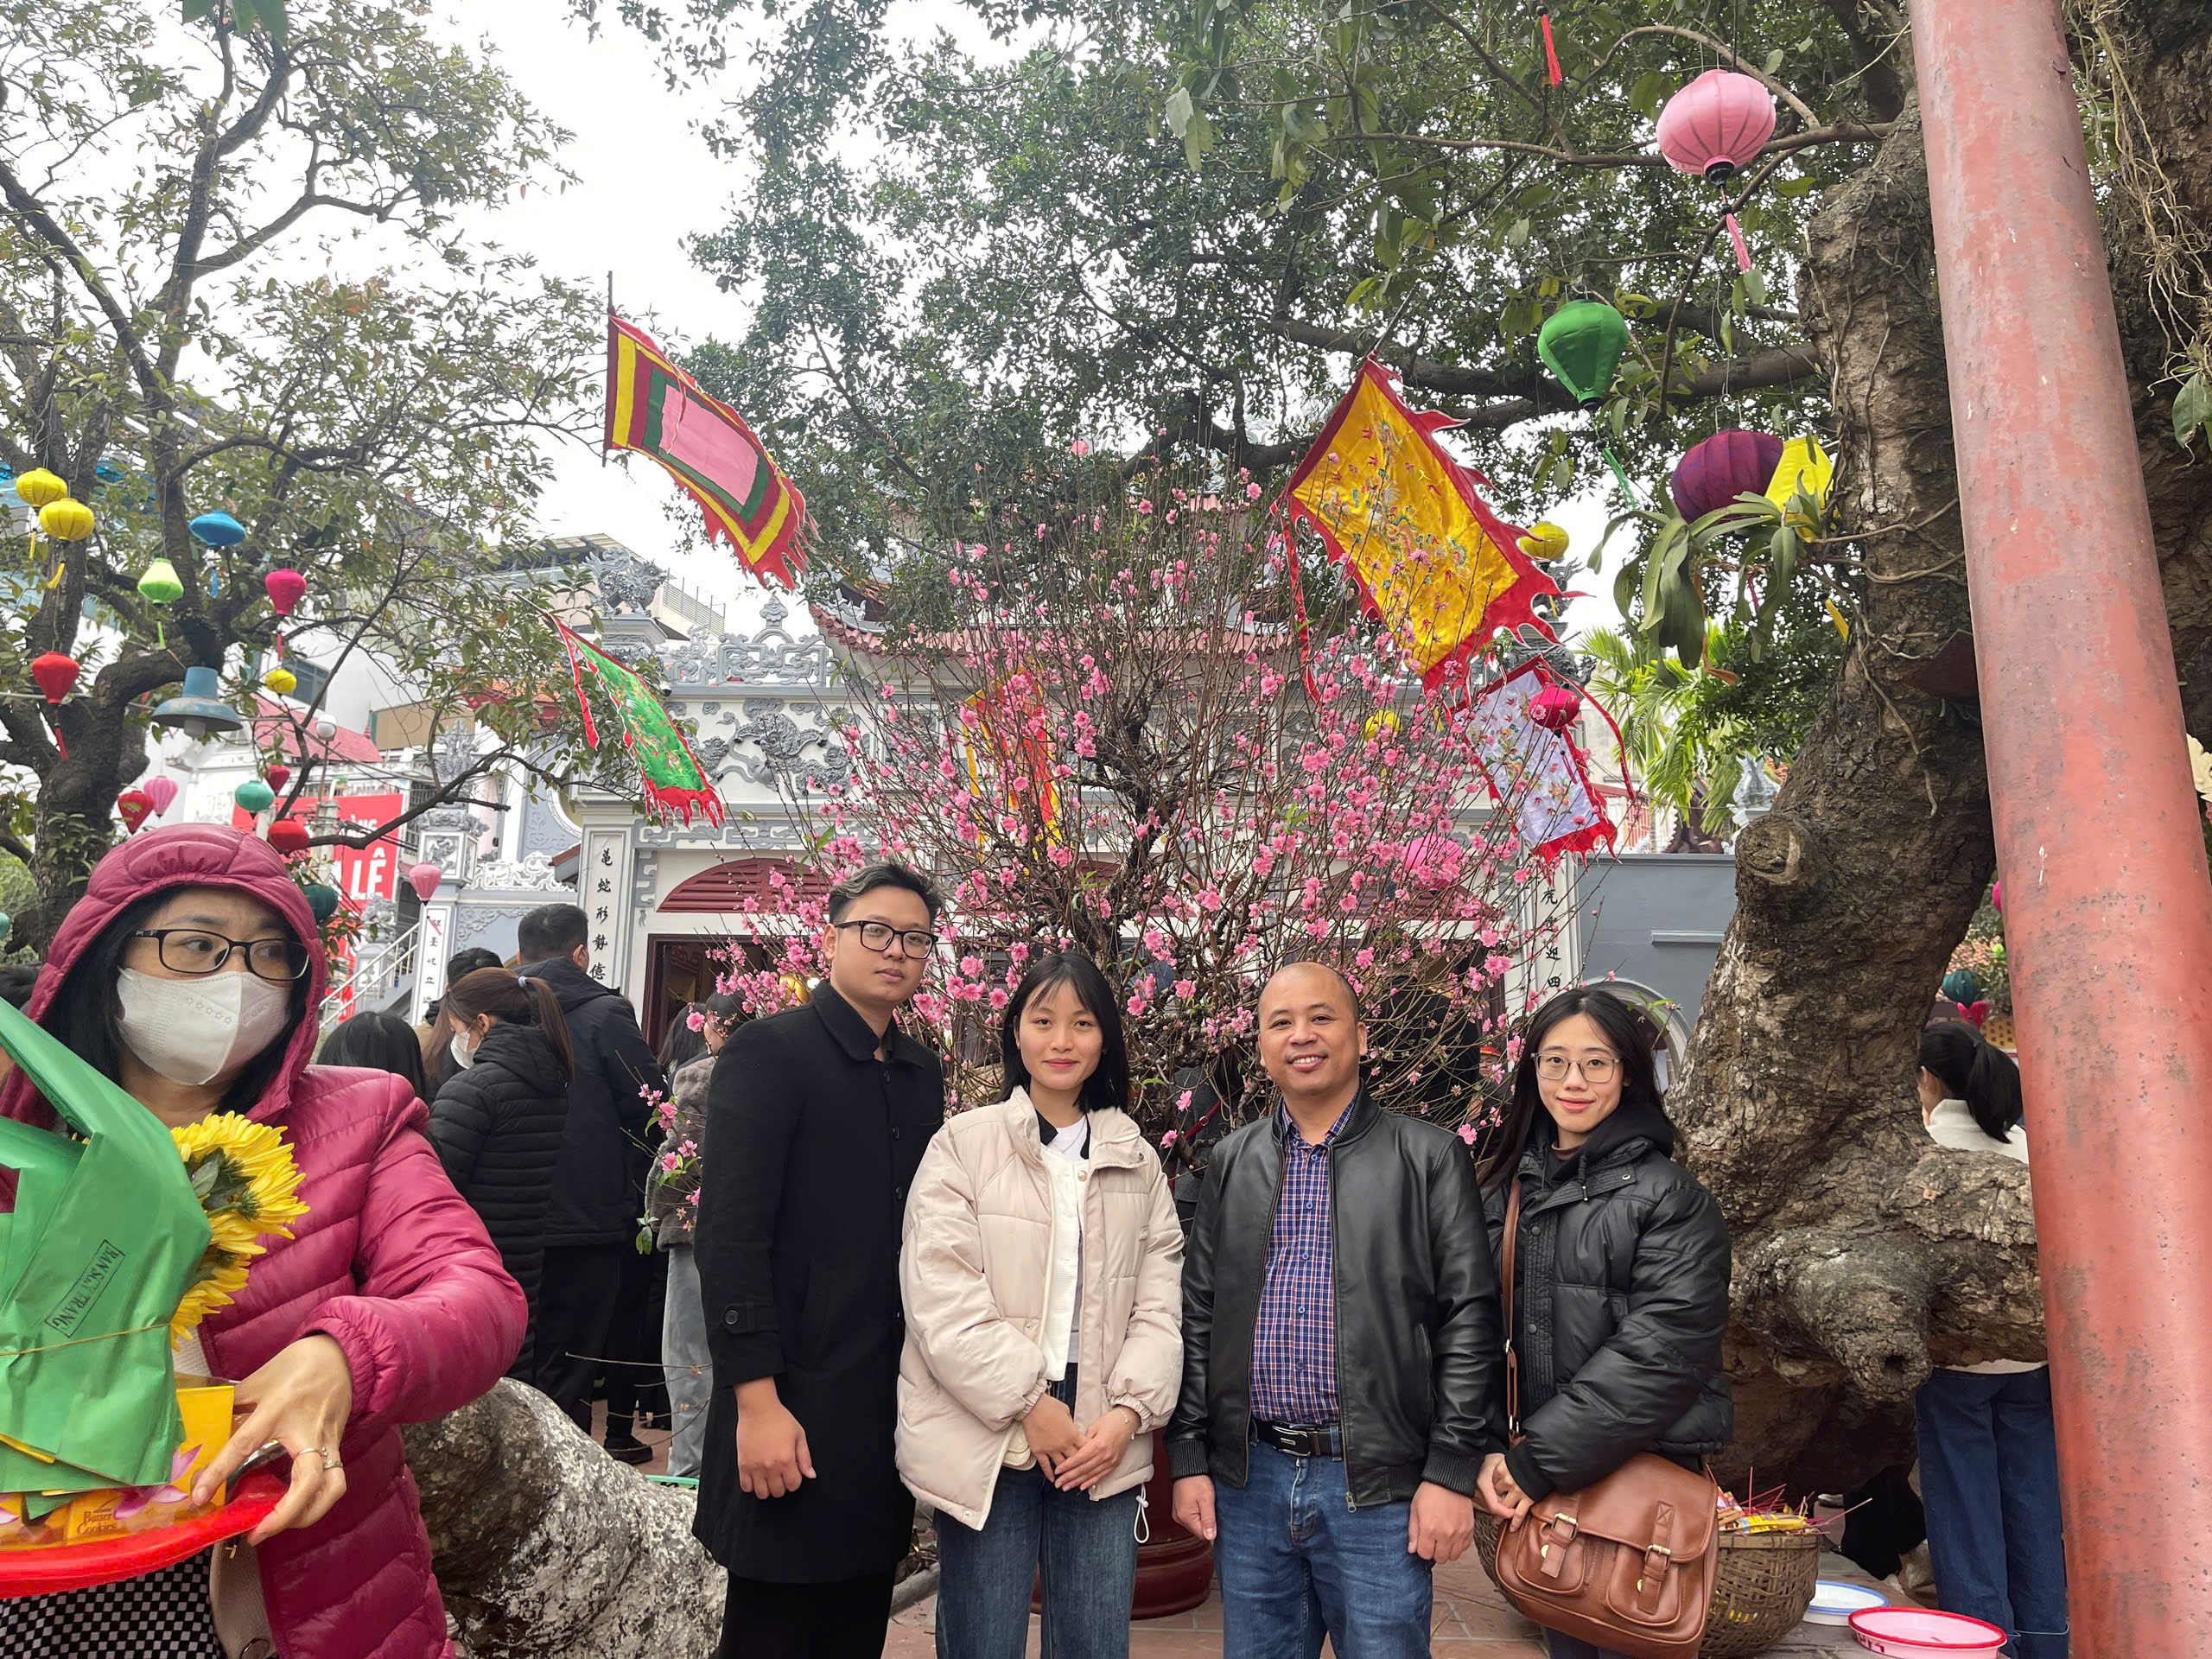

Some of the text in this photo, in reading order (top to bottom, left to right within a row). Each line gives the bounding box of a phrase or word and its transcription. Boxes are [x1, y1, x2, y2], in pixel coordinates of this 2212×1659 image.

[97, 1246, 120, 1274] BAN
[53, 1291, 91, 1331] TRANG
[77, 1522, 117, 1535] Cookies
